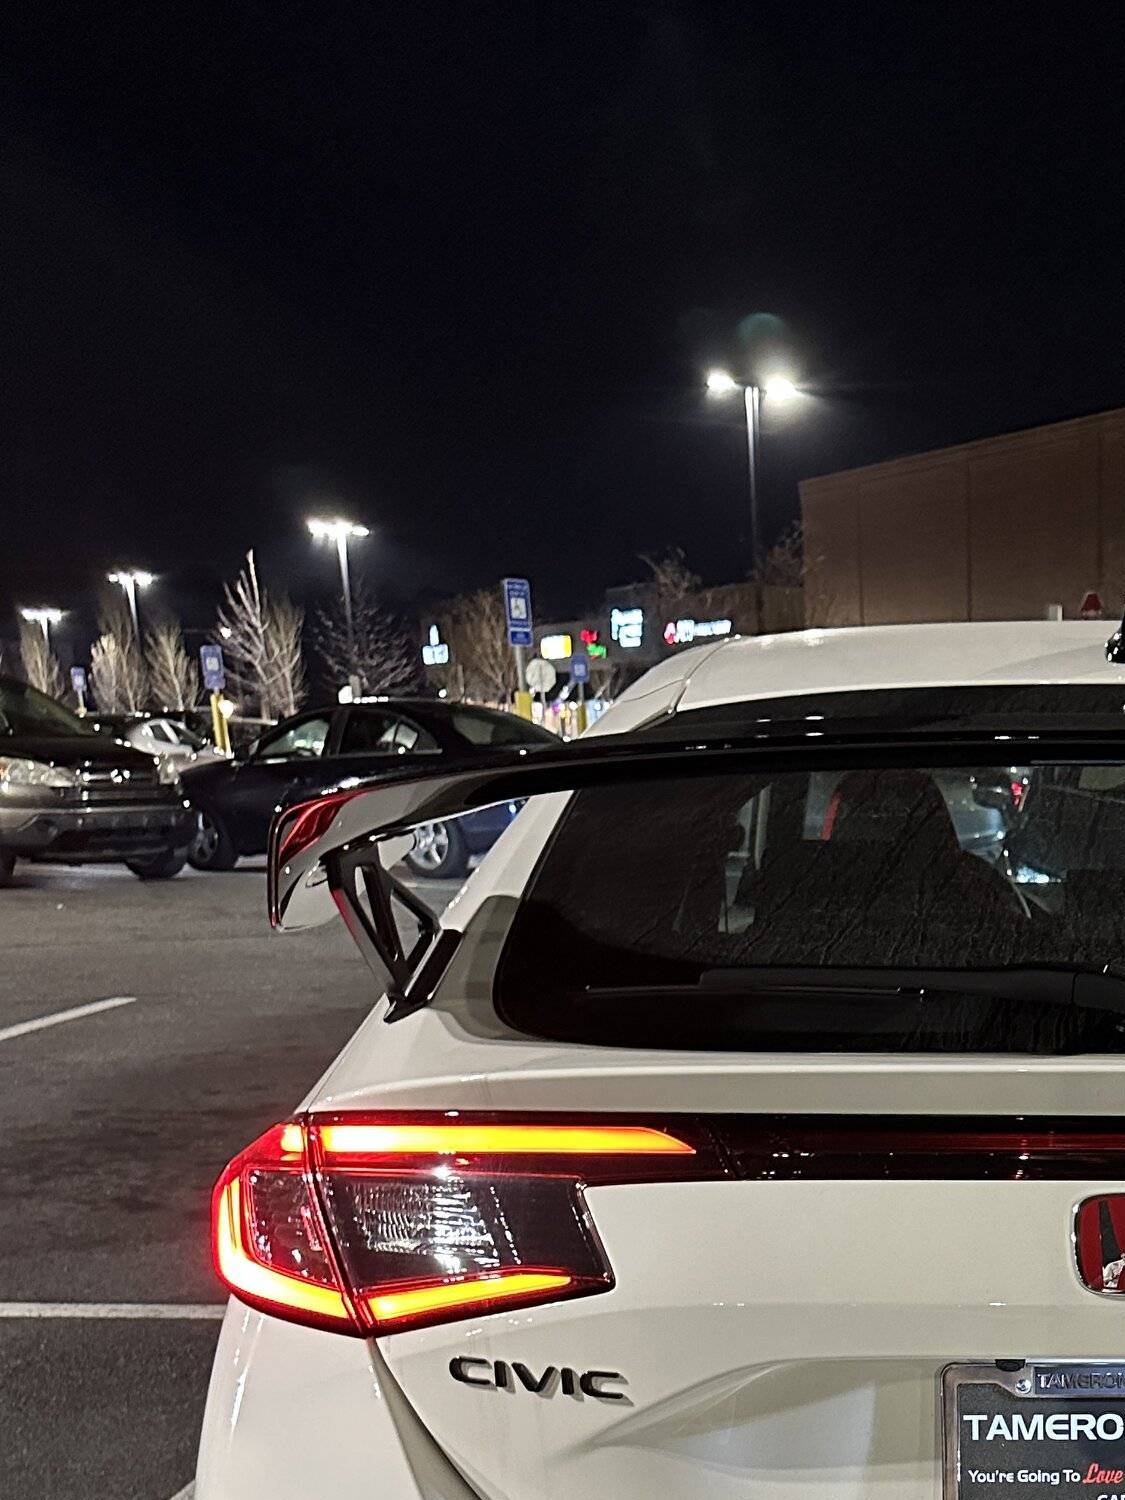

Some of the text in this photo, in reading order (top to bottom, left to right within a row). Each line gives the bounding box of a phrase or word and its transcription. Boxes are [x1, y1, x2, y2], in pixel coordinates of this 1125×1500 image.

[448, 1355, 625, 1399] CIVIC
[967, 1469, 1014, 1484] You're
[1017, 1469, 1060, 1486] Going
[1062, 1469, 1081, 1484] To
[1082, 1462, 1125, 1485] Love
